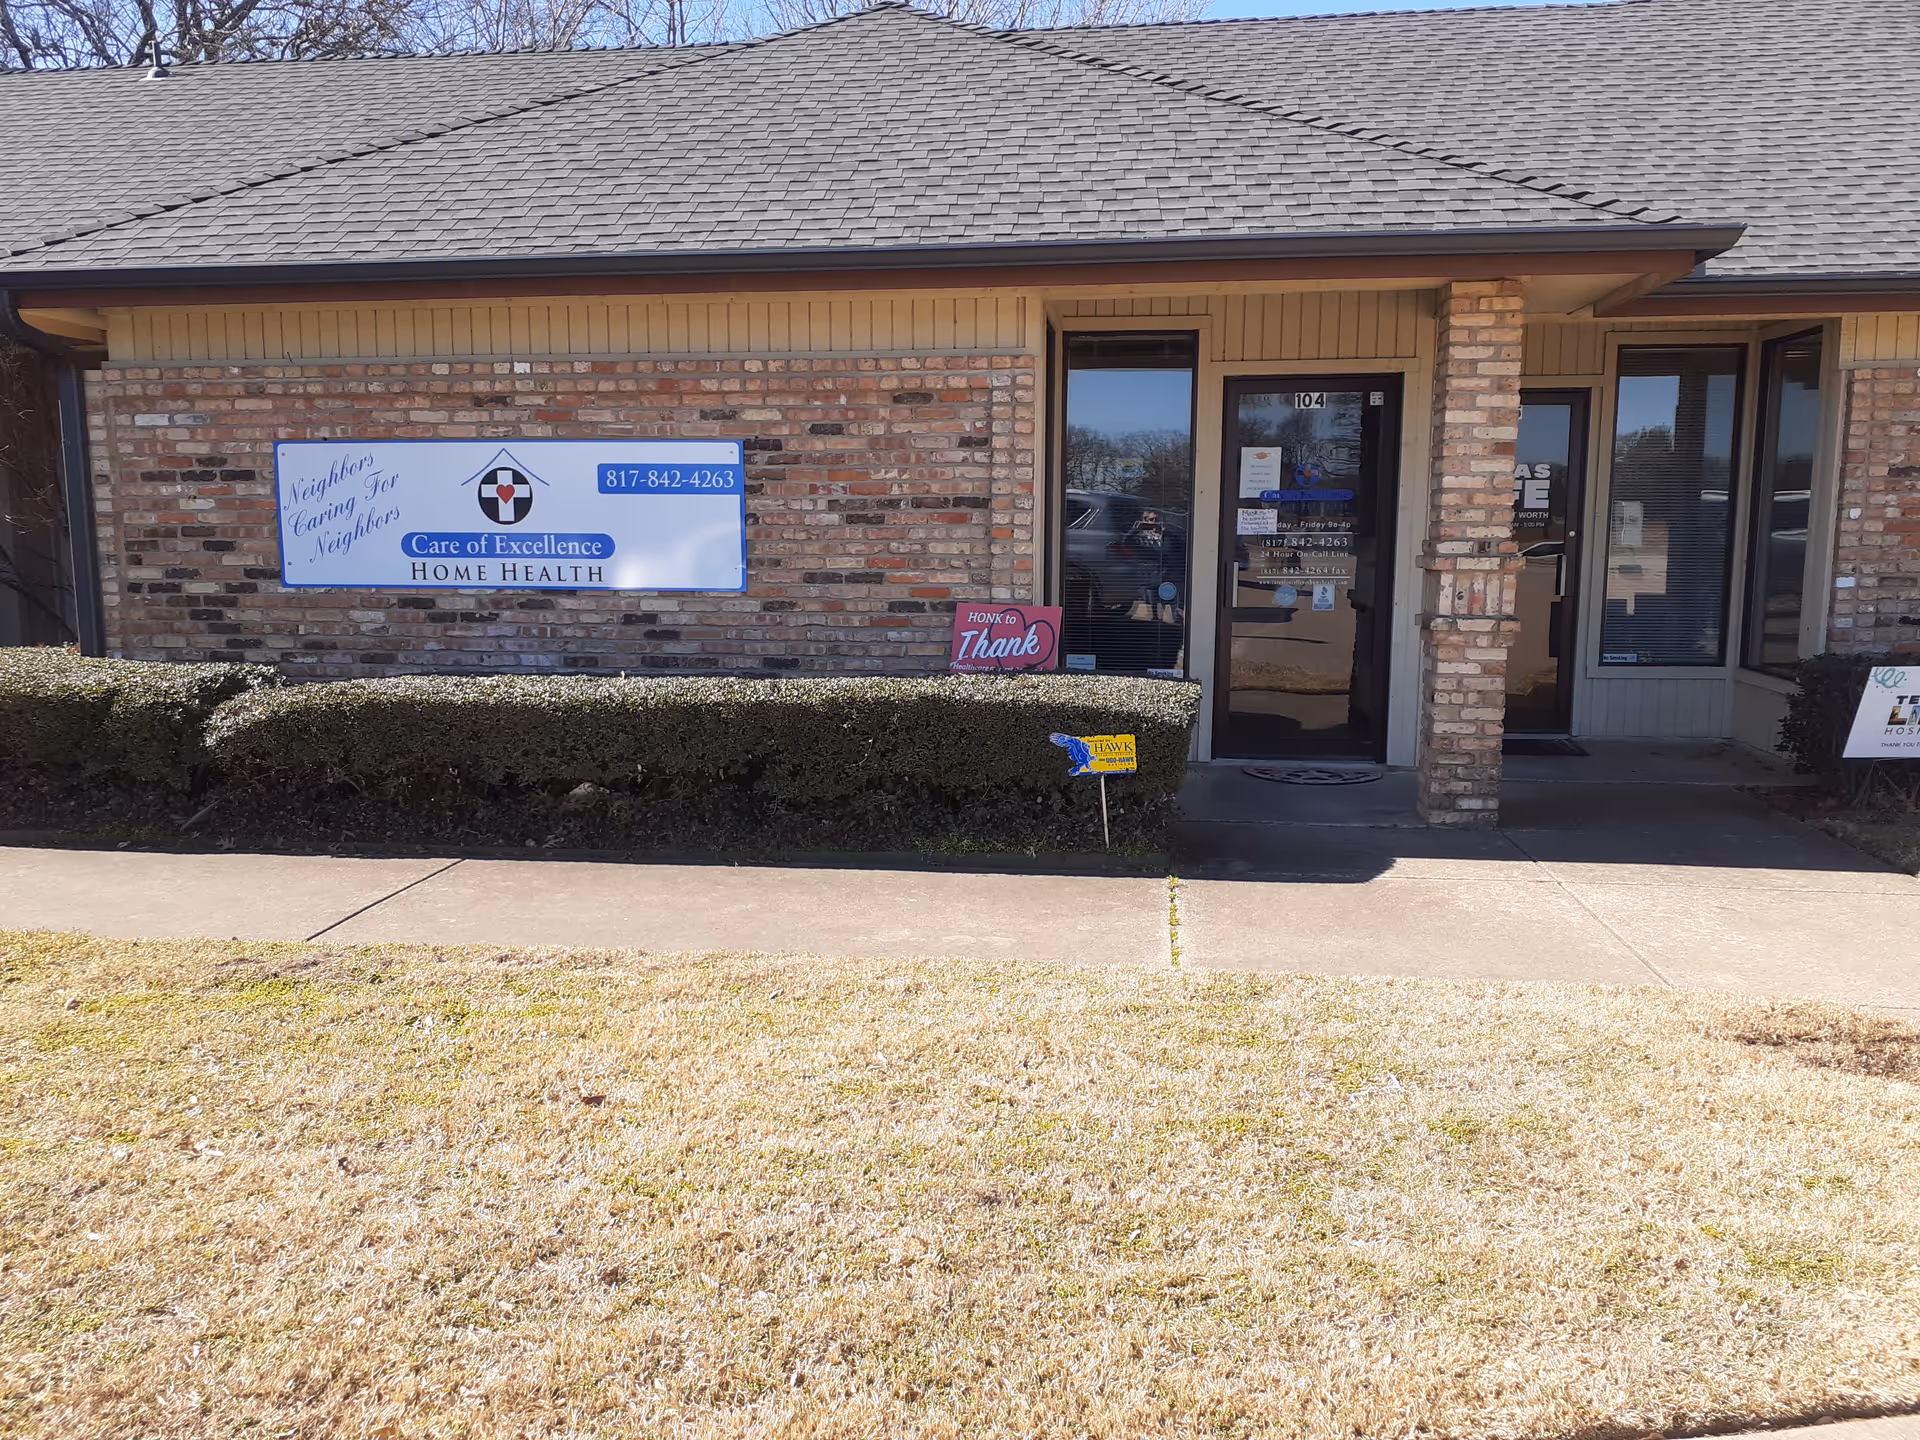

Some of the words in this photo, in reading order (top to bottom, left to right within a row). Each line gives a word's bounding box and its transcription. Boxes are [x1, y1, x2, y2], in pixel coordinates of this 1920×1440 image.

[1295, 393, 1325, 408] 104
[606, 469, 734, 488] 817-842-4263
[1513, 463, 1551, 479] AS
[283, 452, 374, 511] Neighbors
[287, 496, 358, 537] Caring
[364, 469, 399, 501] For
[1518, 511, 1549, 519] WORTH
[1277, 521, 1292, 529] day
[1300, 521, 1328, 529] Friday
[309, 506, 400, 564] Neighbors
[1291, 537, 1348, 547] 842-4263
[411, 534, 460, 555] Care
[466, 533, 489, 554] of
[494, 534, 602, 556] Excellence
[1296, 550, 1328, 558] On-Call
[1331, 550, 1349, 558] Line
[411, 562, 488, 581] HOME
[501, 562, 604, 583] HEALTH
[1282, 566, 1328, 575] 842-4264
[1331, 566, 1346, 575] fax
[967, 611, 1004, 624] HONK
[1005, 613, 1017, 625] to
[957, 623, 1040, 661] Thank
[1884, 727, 1920, 735] HOS
[1094, 741, 1133, 753] HAWK
